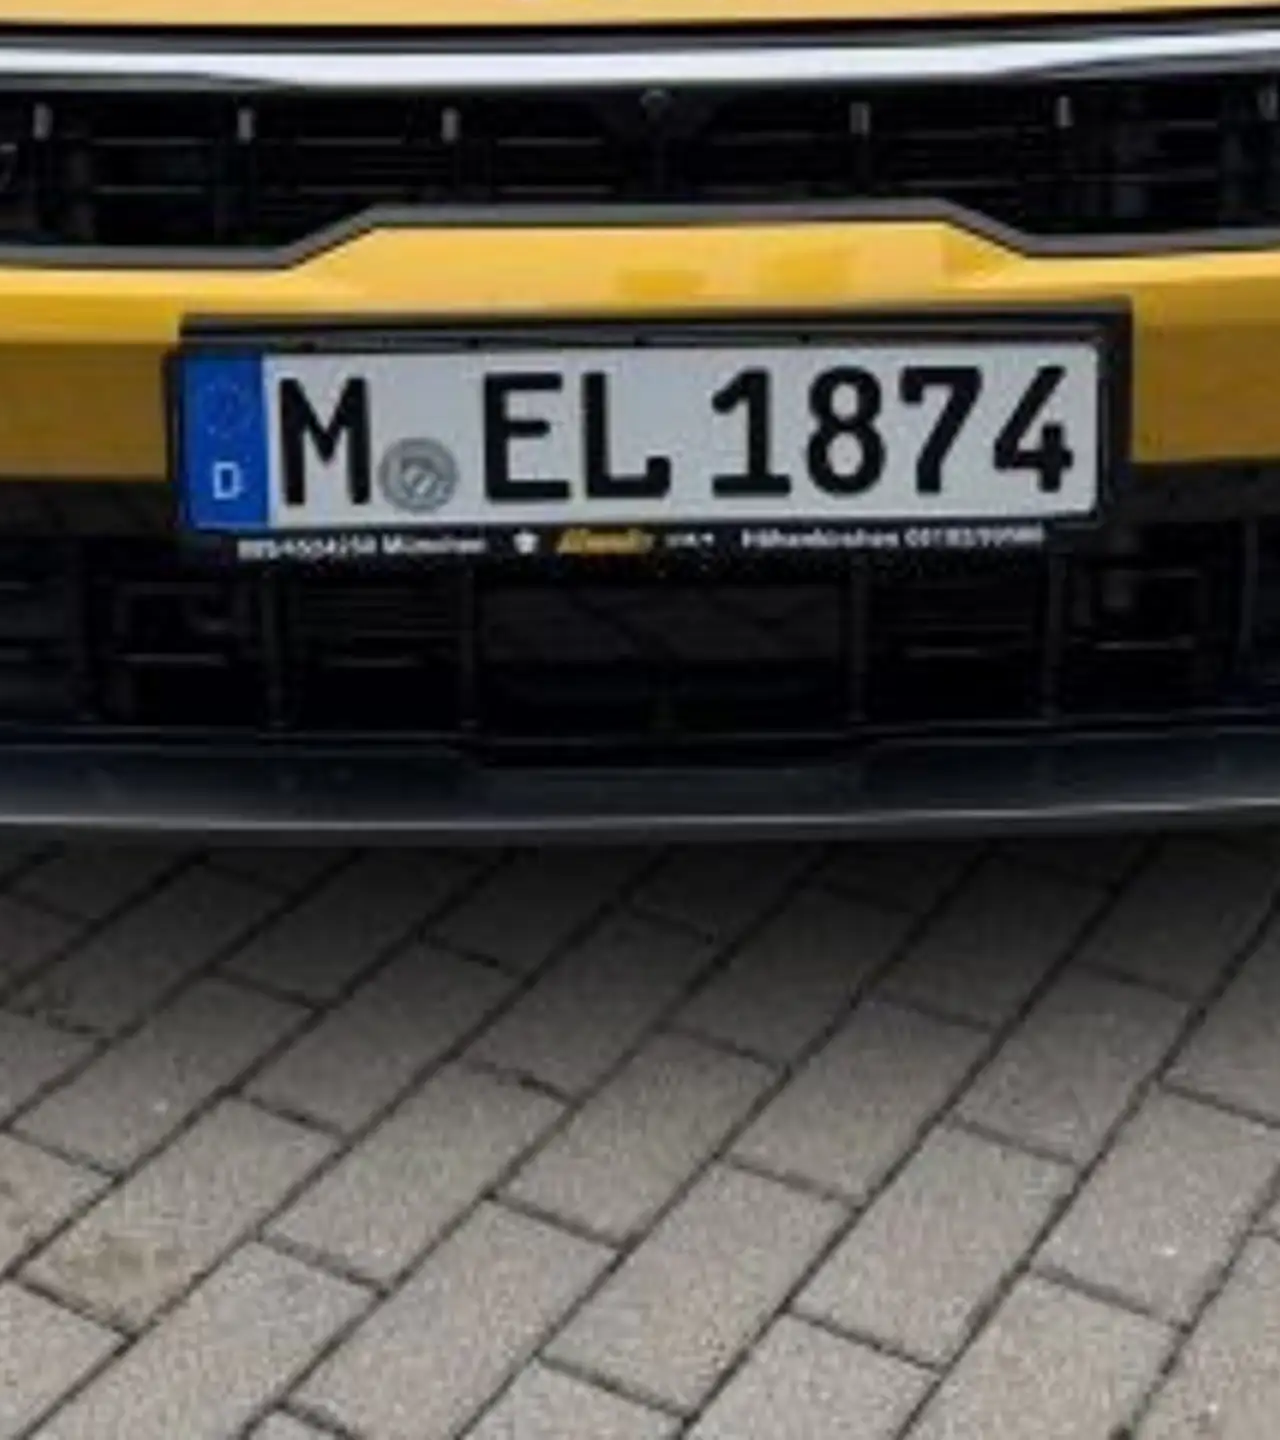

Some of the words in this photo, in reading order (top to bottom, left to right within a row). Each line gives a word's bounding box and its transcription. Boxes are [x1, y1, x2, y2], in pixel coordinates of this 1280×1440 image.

[213, 461, 244, 500] D
[278, 376, 372, 506] M
[483, 370, 672, 503] EL
[712, 365, 1074, 498] 1874
